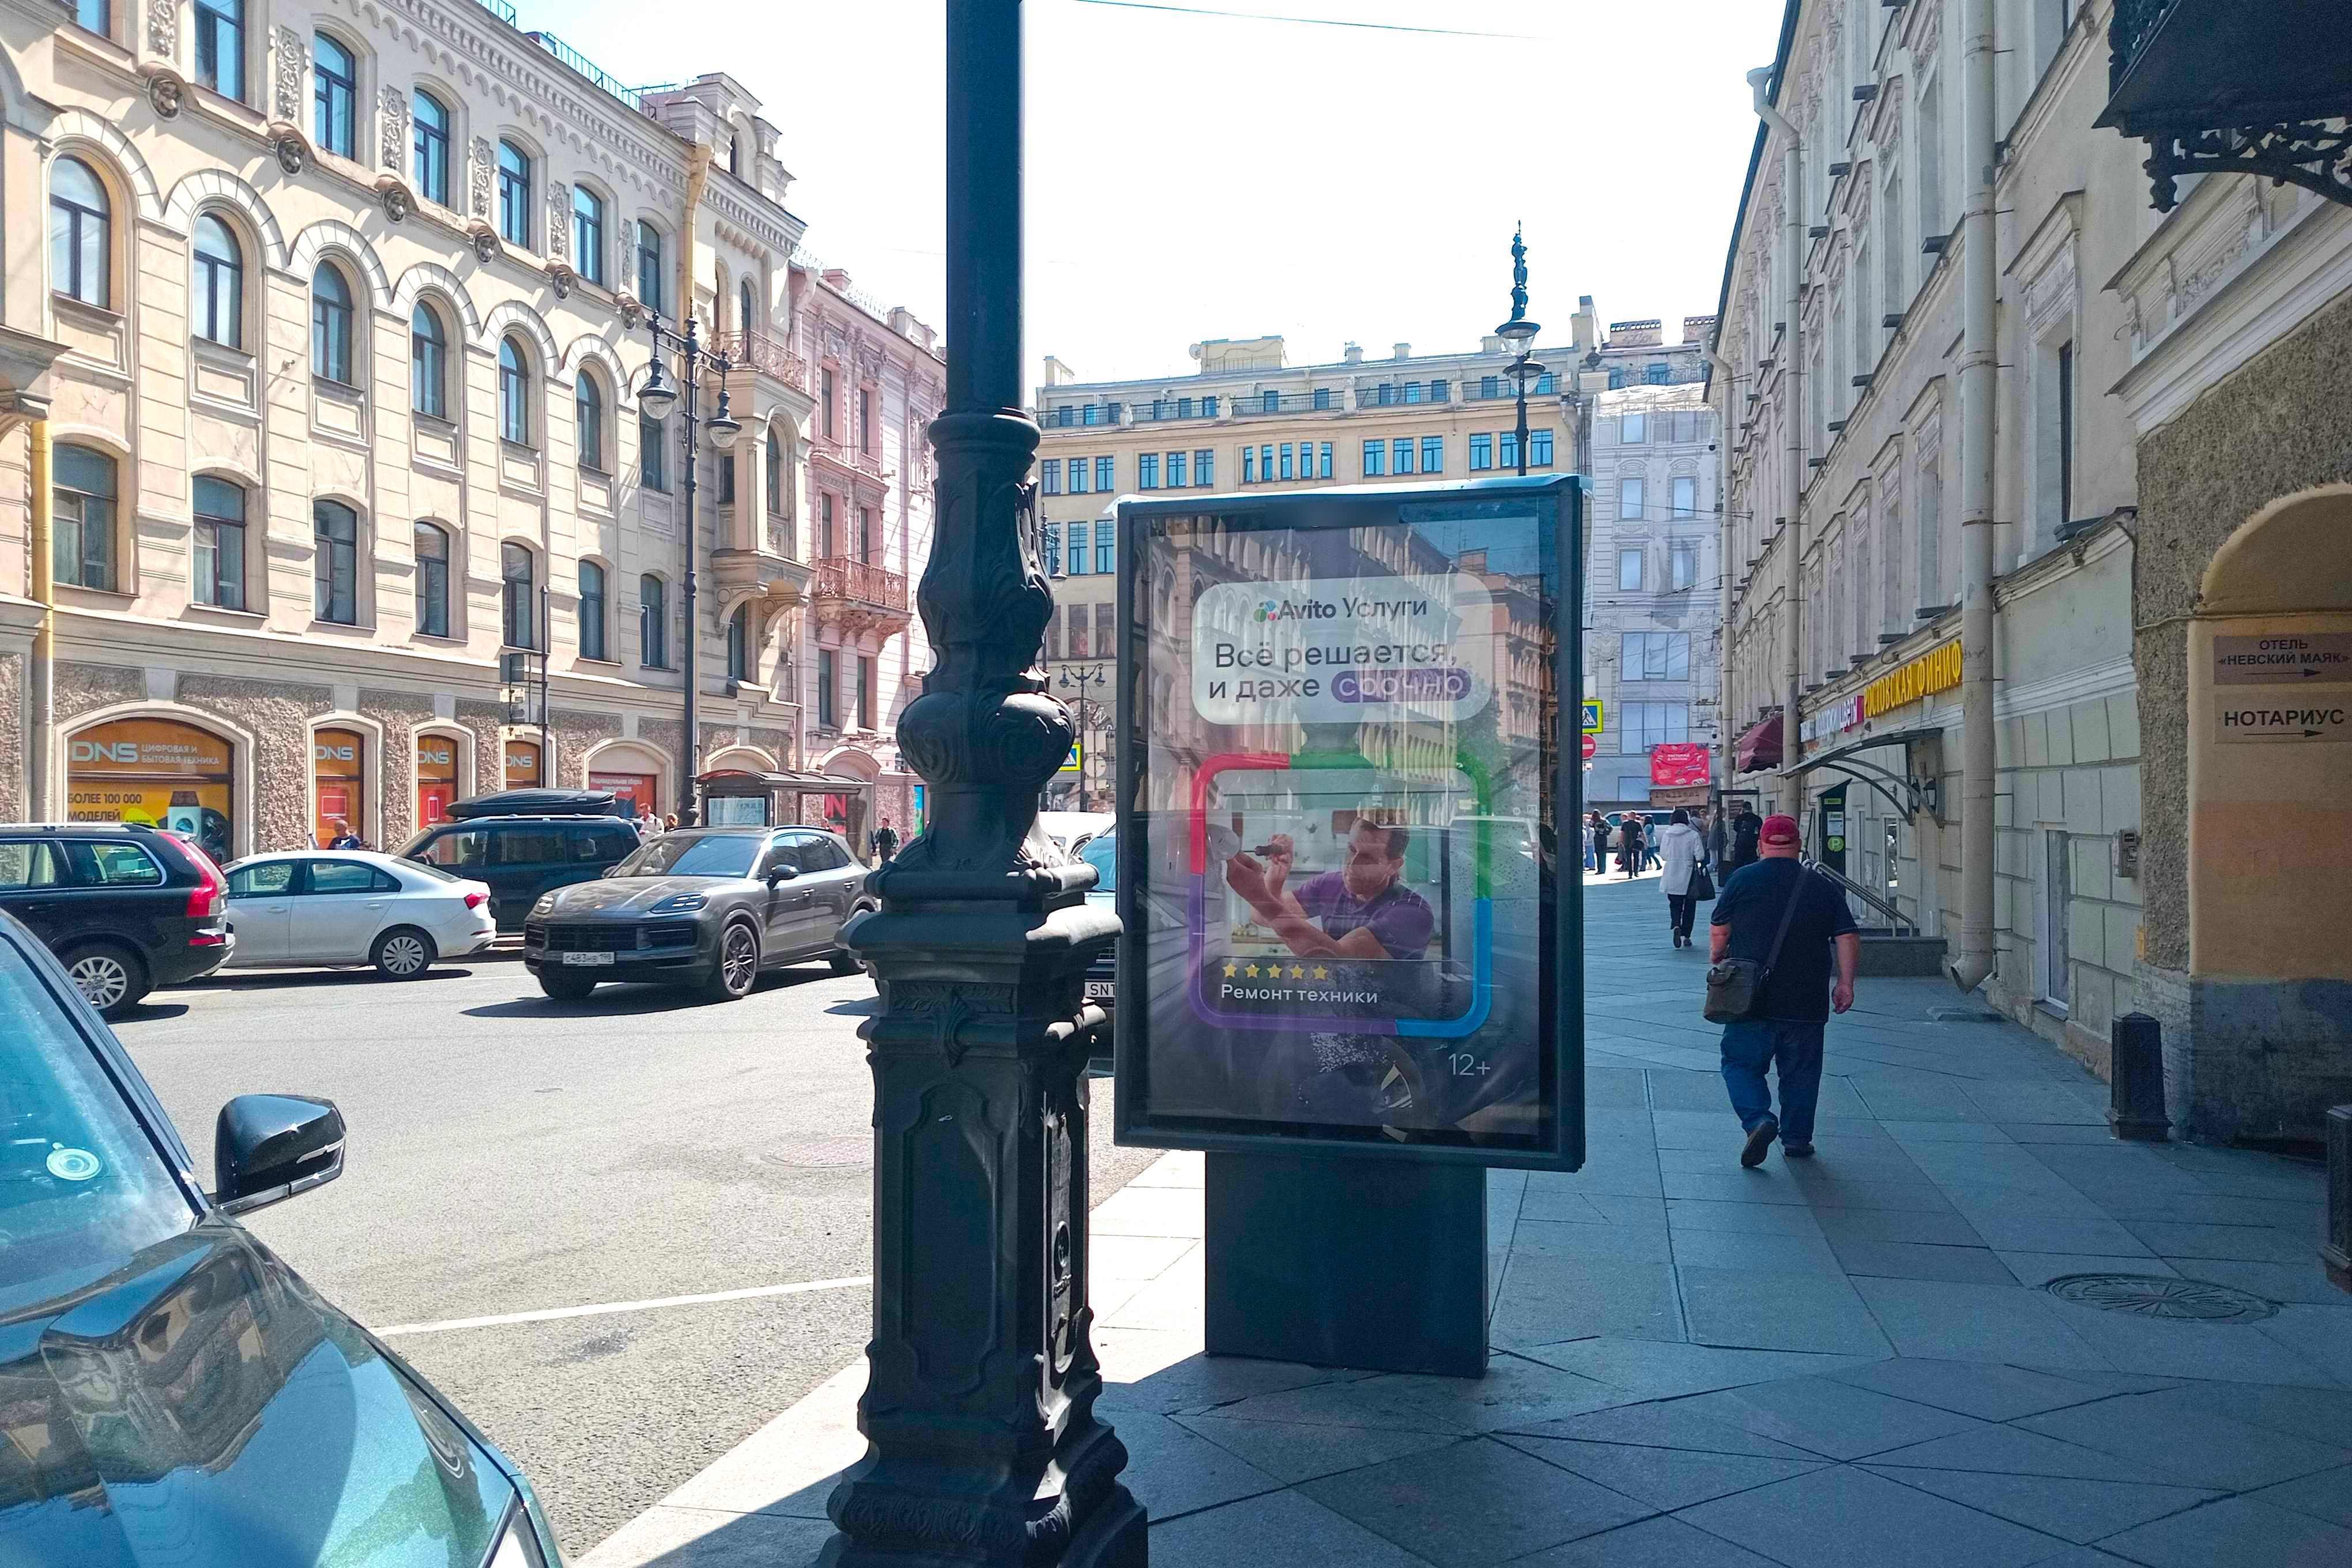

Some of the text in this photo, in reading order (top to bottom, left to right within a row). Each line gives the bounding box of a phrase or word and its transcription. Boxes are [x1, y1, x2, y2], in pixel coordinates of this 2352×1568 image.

[1277, 597, 1427, 621] Avito Услуги
[2259, 639, 2308, 650] ОТЕЛЬ
[1216, 642, 1457, 672] Всё решается,
[2218, 652, 2351, 665] «НЕВСКИЙ МАЯК»
[1863, 640, 1961, 718] РОСТОВСКАЯ ФИНИФ
[1209, 674, 1464, 703] и даже срочно
[2224, 709, 2345, 726] НОТАРИУС
[71, 741, 138, 763] DNS
[141, 744, 191, 753] ЦИФРОВАЯ
[315, 745, 354, 760] DNS
[141, 755, 220, 765] БЫТОВАЯ ТЕХНИКА
[418, 751, 450, 764] DNS
[506, 755, 533, 768] DNS
[67, 793, 142, 804] БОЛЕЕ 100 000
[67, 808, 120, 822] МОДЕЛЕЙ
[1221, 983, 1378, 1004] Ремонт техники
[1447, 1053, 1491, 1076] 12+
